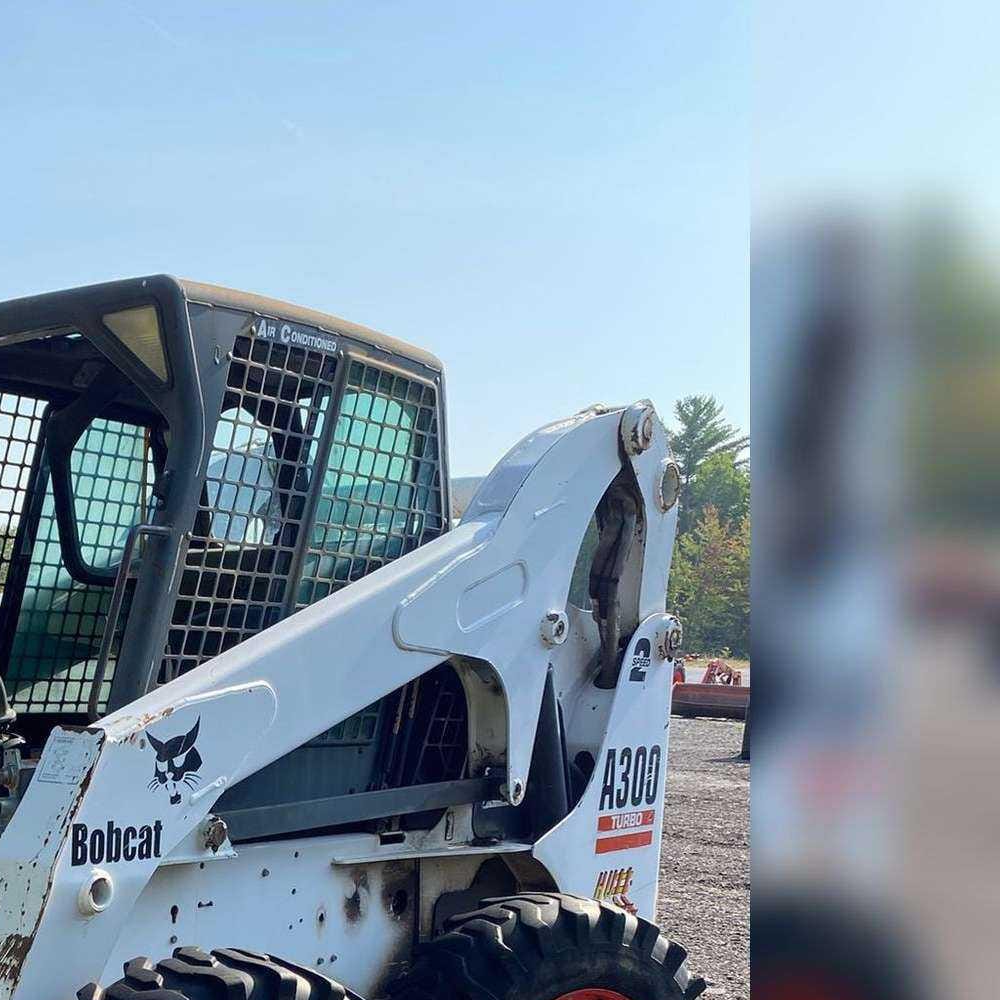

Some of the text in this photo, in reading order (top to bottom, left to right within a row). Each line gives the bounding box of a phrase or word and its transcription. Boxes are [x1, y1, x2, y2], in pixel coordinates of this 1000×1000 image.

[257, 319, 338, 352] AIR CONDITIONED
[631, 656, 651, 668] SPEED
[599, 744, 661, 811] A300
[611, 811, 643, 830] TURBO
[71, 820, 163, 867] Bobcat
